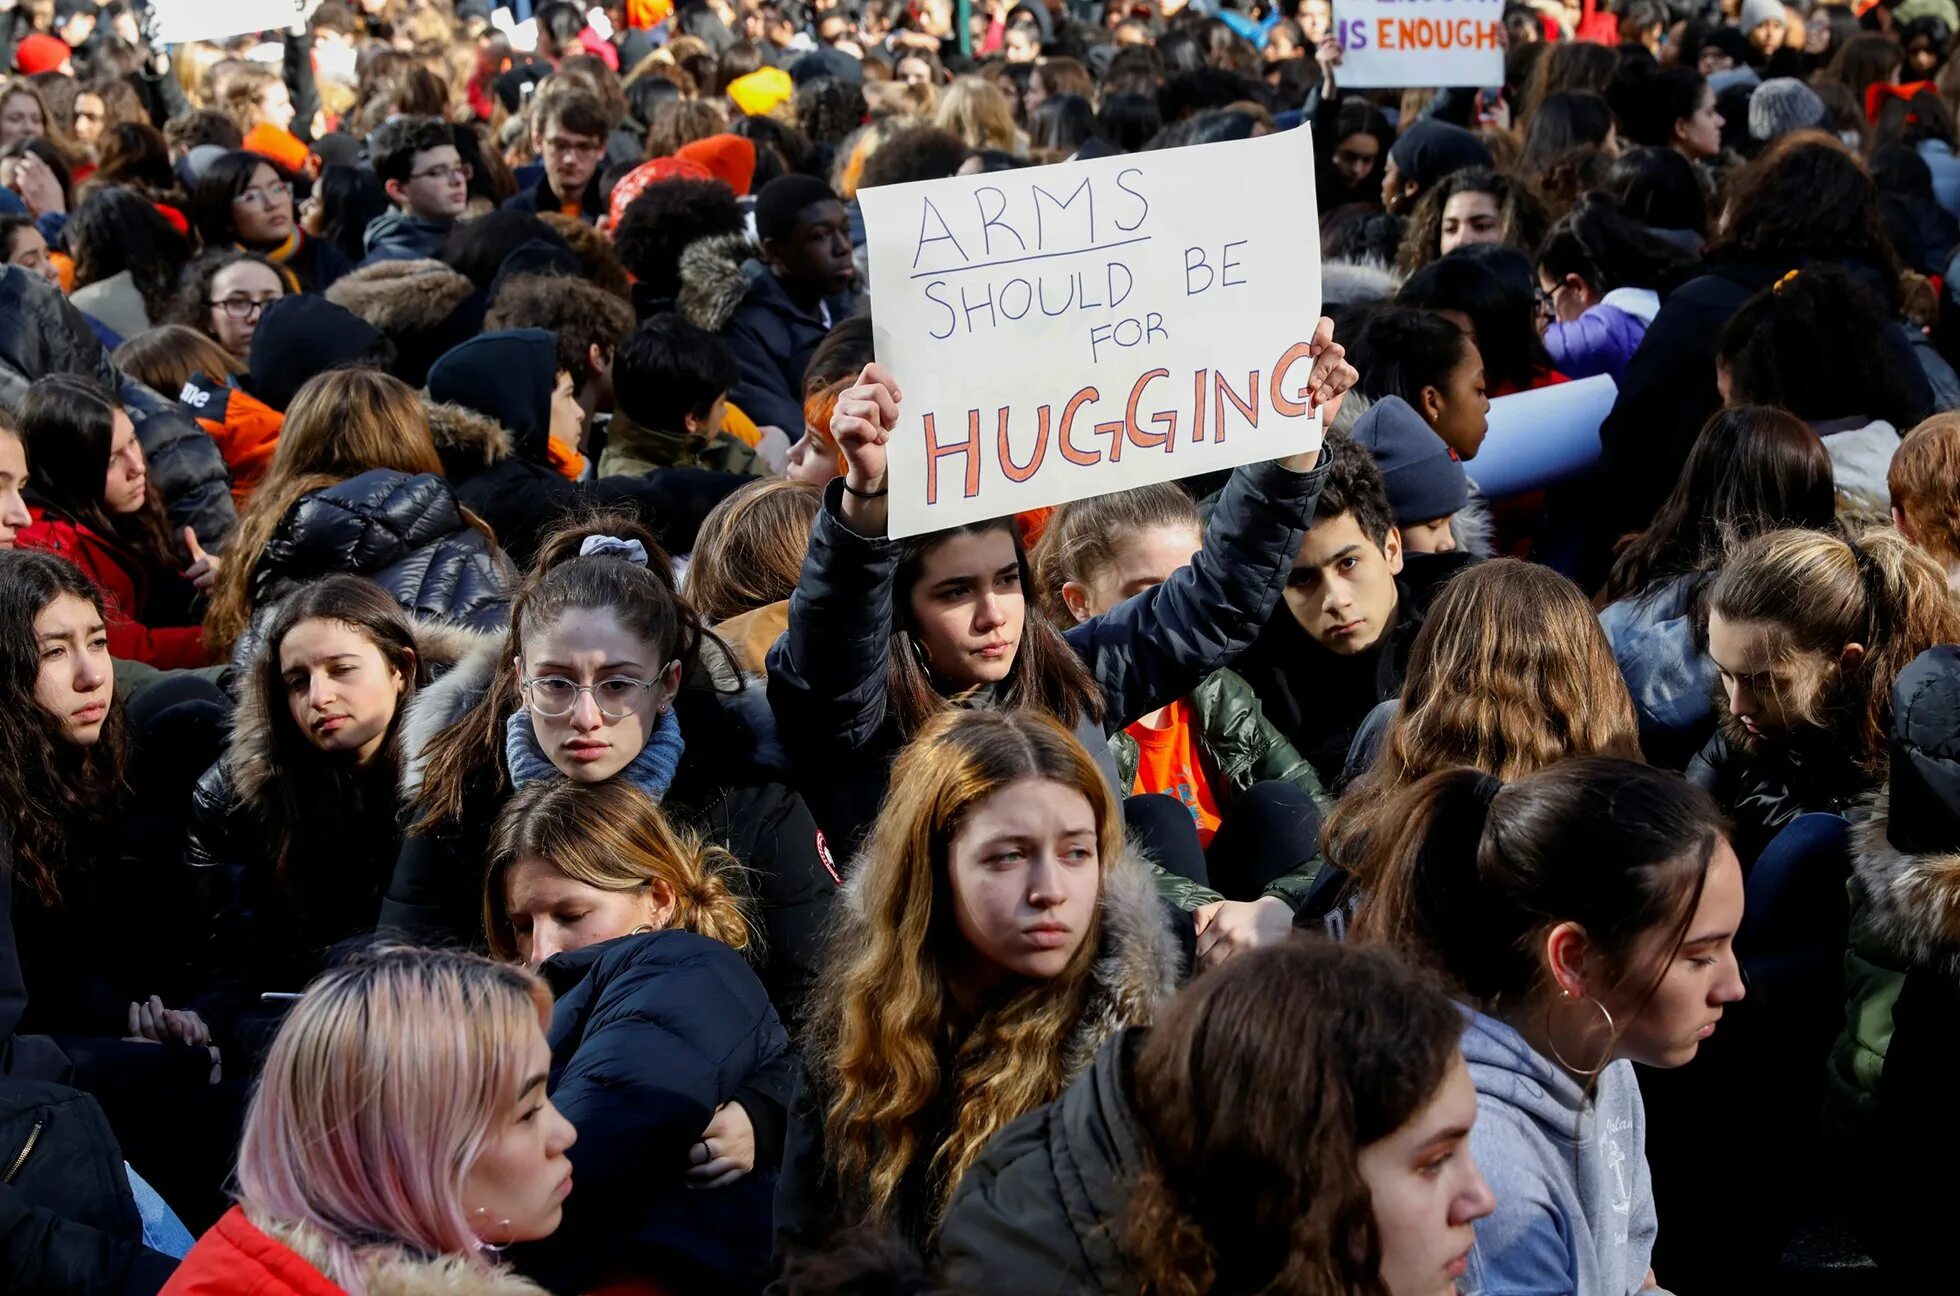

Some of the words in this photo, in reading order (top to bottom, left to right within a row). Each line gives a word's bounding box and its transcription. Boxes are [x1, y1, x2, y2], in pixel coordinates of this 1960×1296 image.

[1338, 19, 1367, 50] IS
[1376, 18, 1498, 50] ENOUGH
[912, 168, 1150, 269] ARMS
[924, 262, 1133, 339] SHOULD
[1184, 240, 1248, 296] BE
[1090, 311, 1169, 364] FOR
[922, 341, 1316, 505] HUGGING
